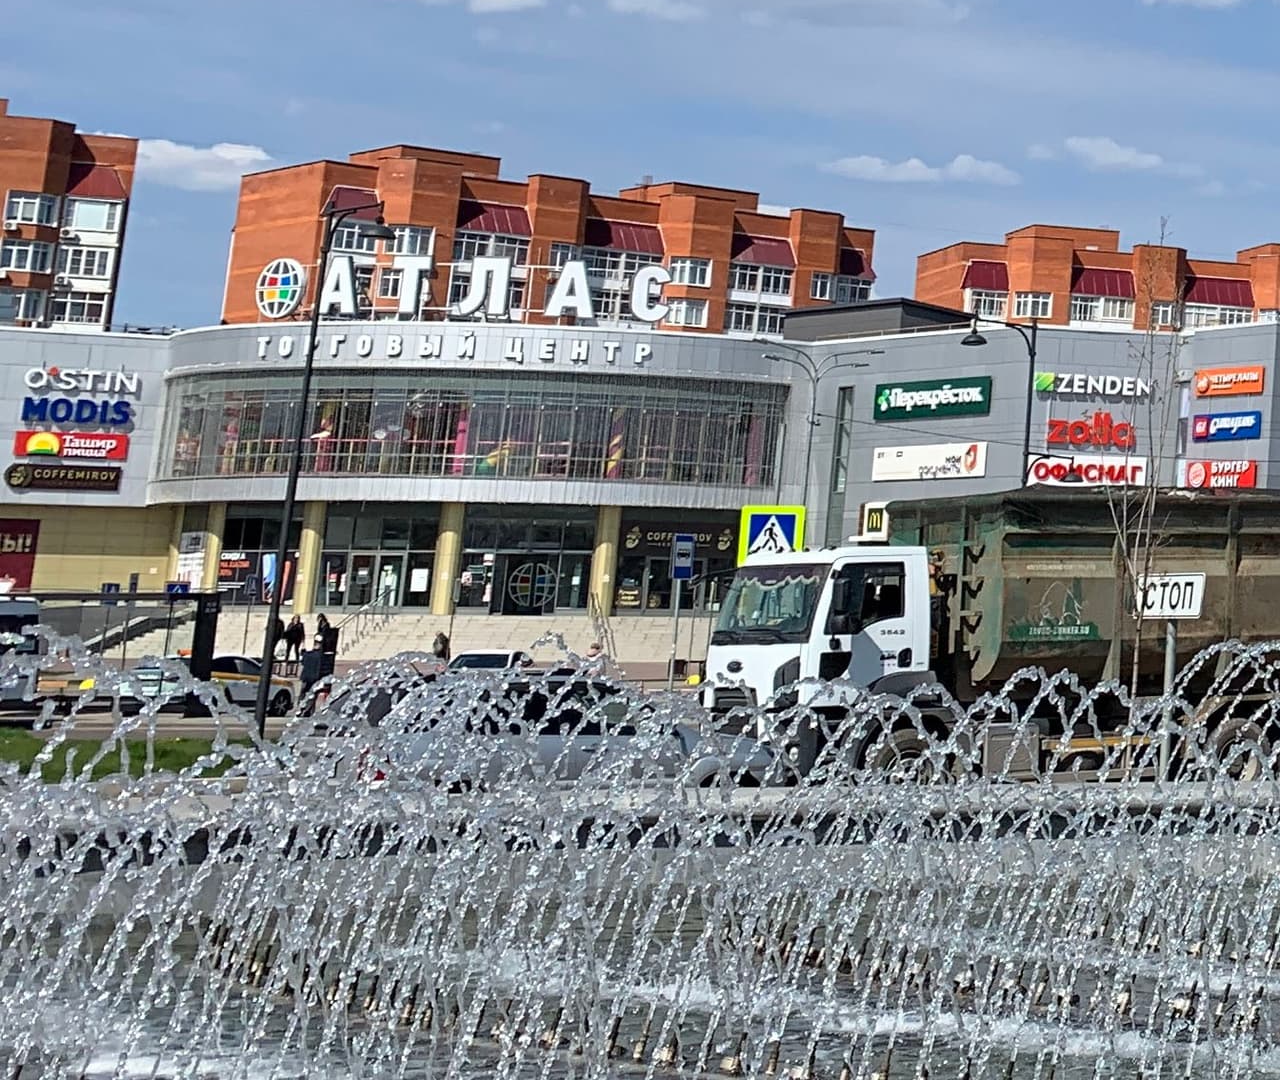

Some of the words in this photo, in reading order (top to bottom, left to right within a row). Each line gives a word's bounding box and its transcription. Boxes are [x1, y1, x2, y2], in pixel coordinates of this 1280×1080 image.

[319, 256, 673, 321] АТЛАС
[257, 331, 477, 358] ТОРГОВЫЙ
[504, 337, 652, 364] ЦЕНТР
[1057, 373, 1152, 396] ZENDEN
[888, 384, 985, 411] Перекрёсток
[22, 397, 131, 424] MODIS
[61, 435, 117, 451] Ташир
[33, 468, 117, 481] COFFEMIROV
[1210, 460, 1249, 474] БУРГЕР
[1210, 474, 1240, 487] КИНГ
[0, 533, 32, 553] Ы!
[647, 532, 712, 542] COFFROV
[1142, 581, 1195, 610] СТОП
